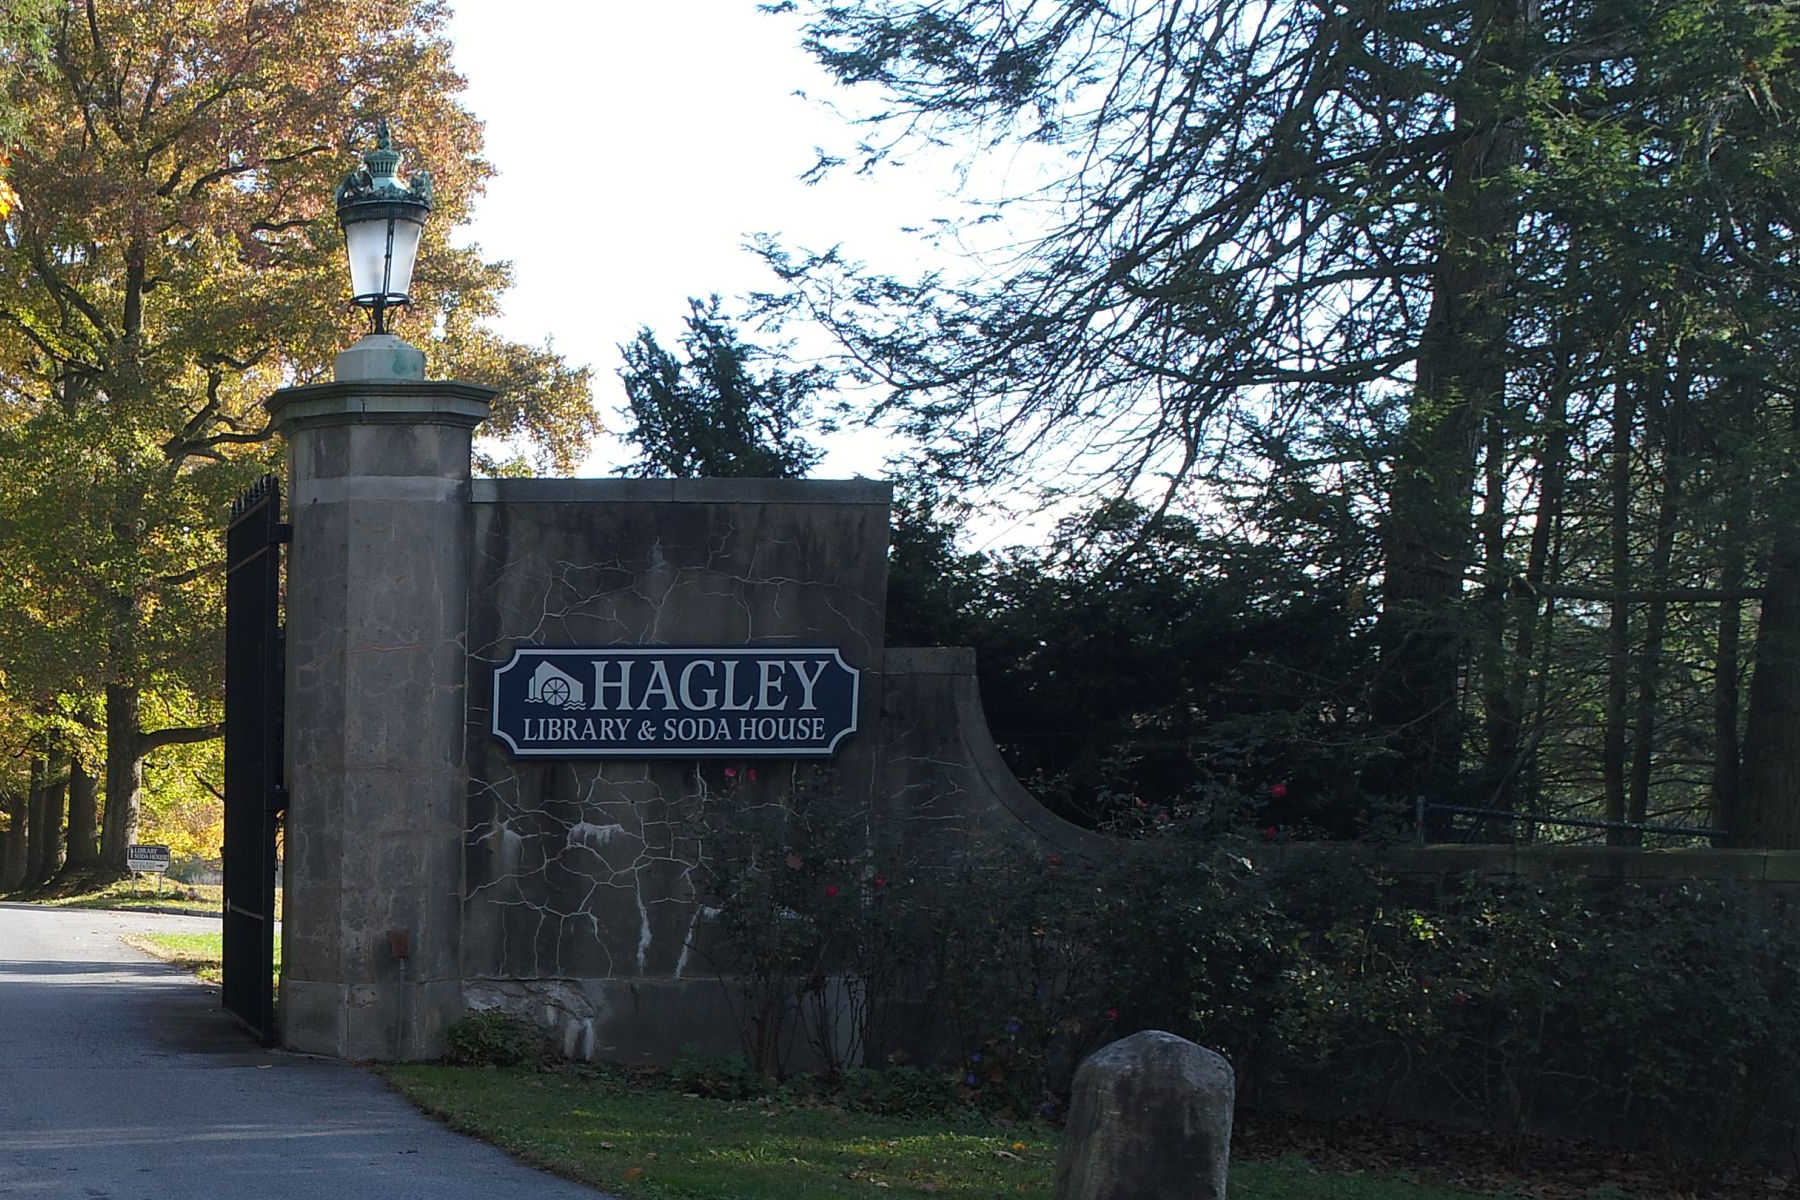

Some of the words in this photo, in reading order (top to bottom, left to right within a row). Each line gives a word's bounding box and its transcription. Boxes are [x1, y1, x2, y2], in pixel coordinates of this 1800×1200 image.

[590, 660, 829, 710] HAGLEY
[523, 717, 631, 741] LIBRARY
[637, 719, 656, 741] &
[663, 717, 732, 740] SODA
[739, 717, 826, 740] HOUSE
